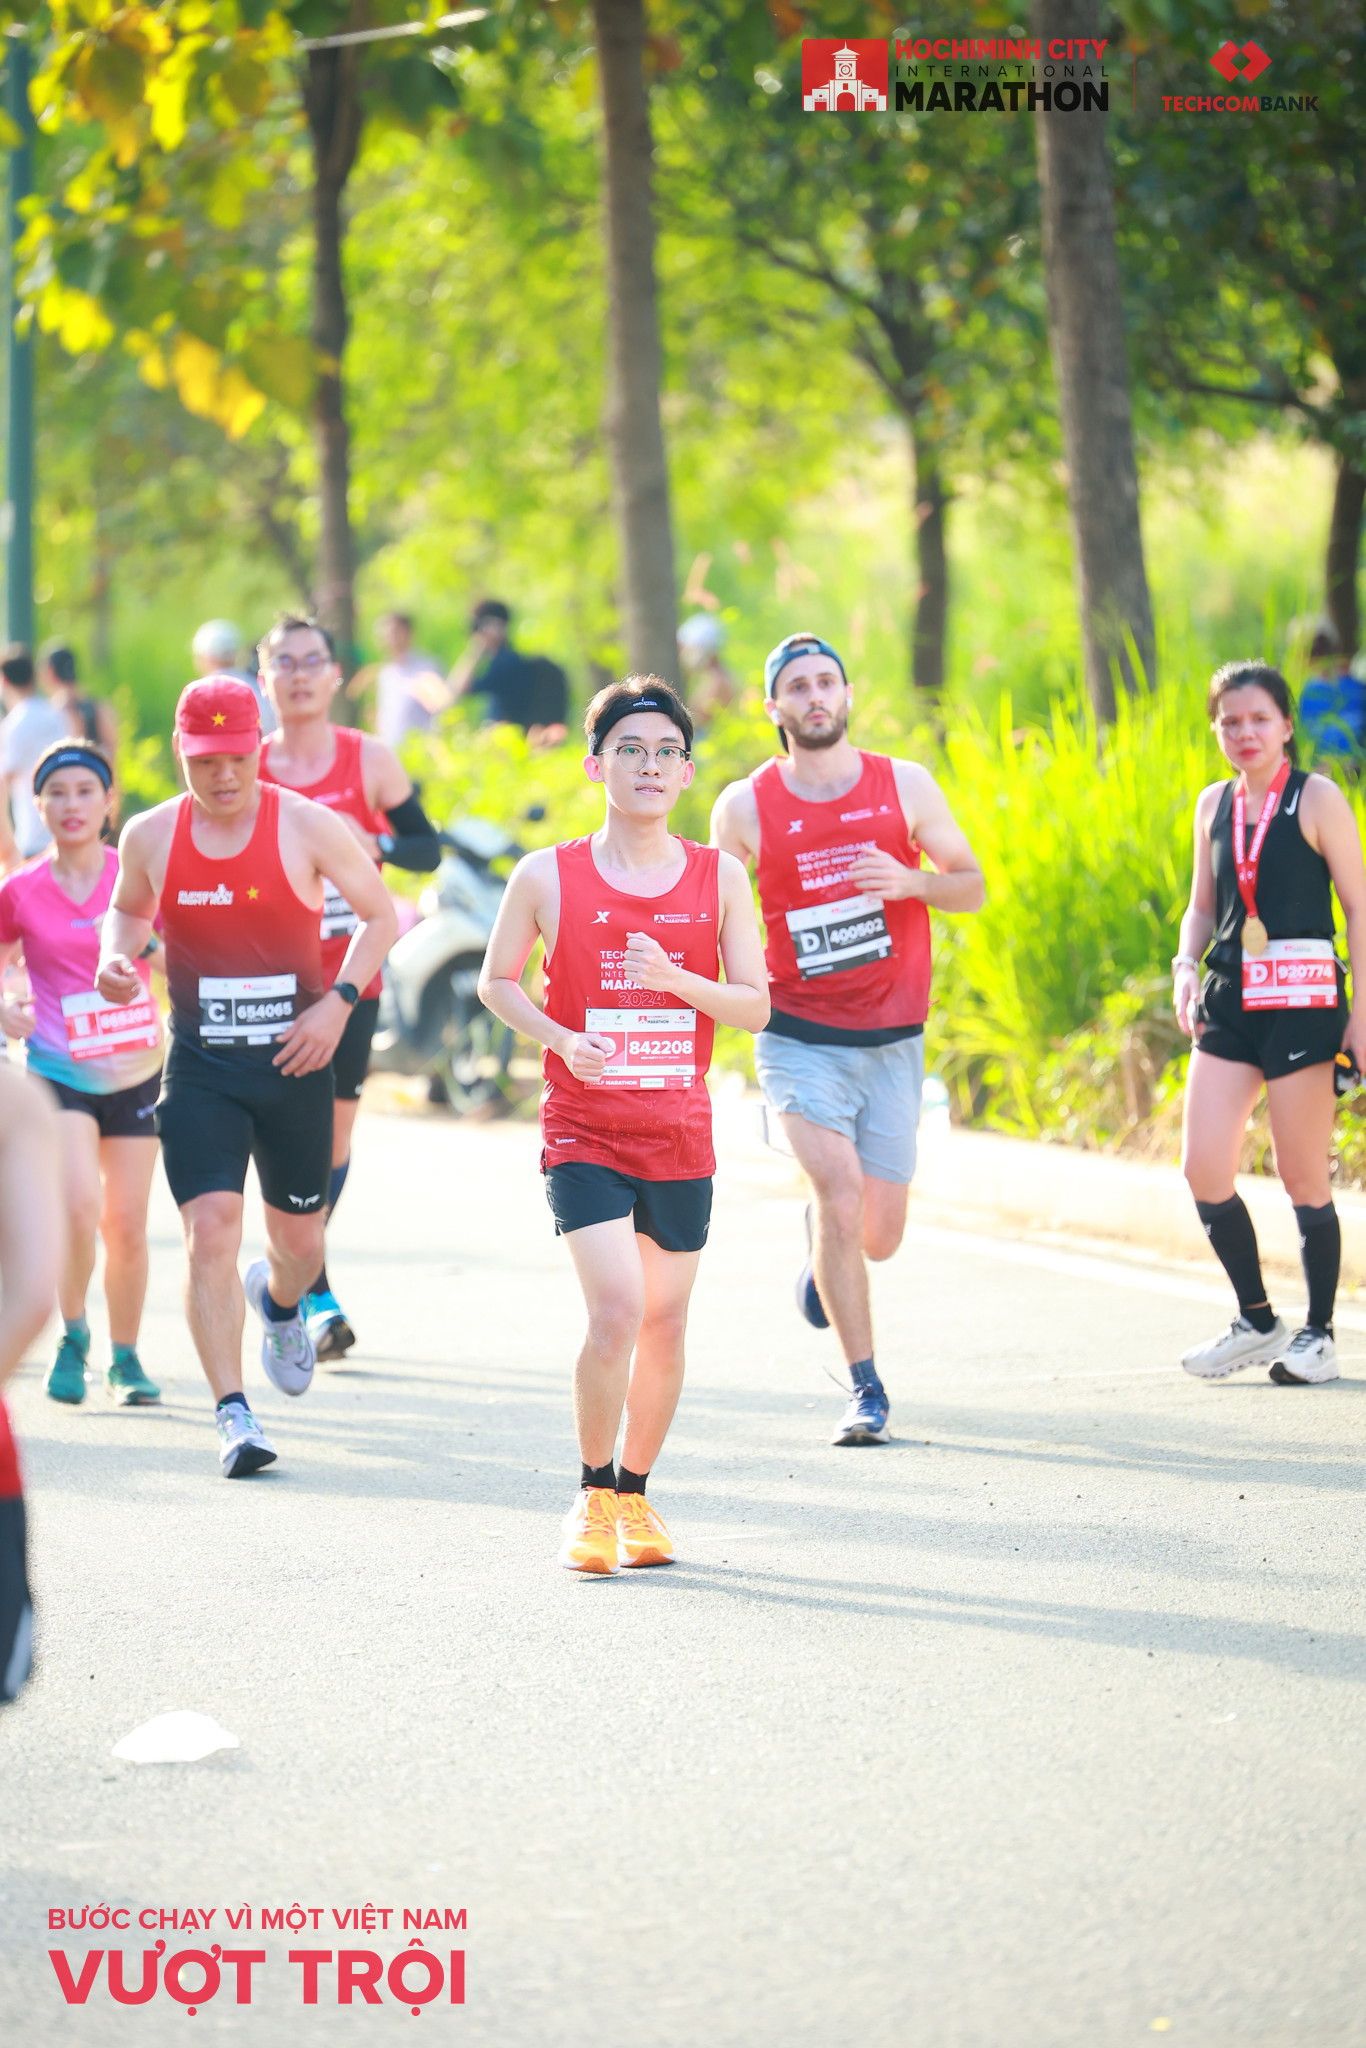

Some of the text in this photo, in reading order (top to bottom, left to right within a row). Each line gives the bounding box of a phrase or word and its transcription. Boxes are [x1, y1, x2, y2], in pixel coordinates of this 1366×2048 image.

[801, 931, 821, 953] D
[601, 961, 614, 969] HO
[1250, 963, 1268, 985] D
[618, 991, 667, 1007] 2024
[208, 1001, 293, 1023] C 654065
[629, 1040, 693, 1055] 842208
